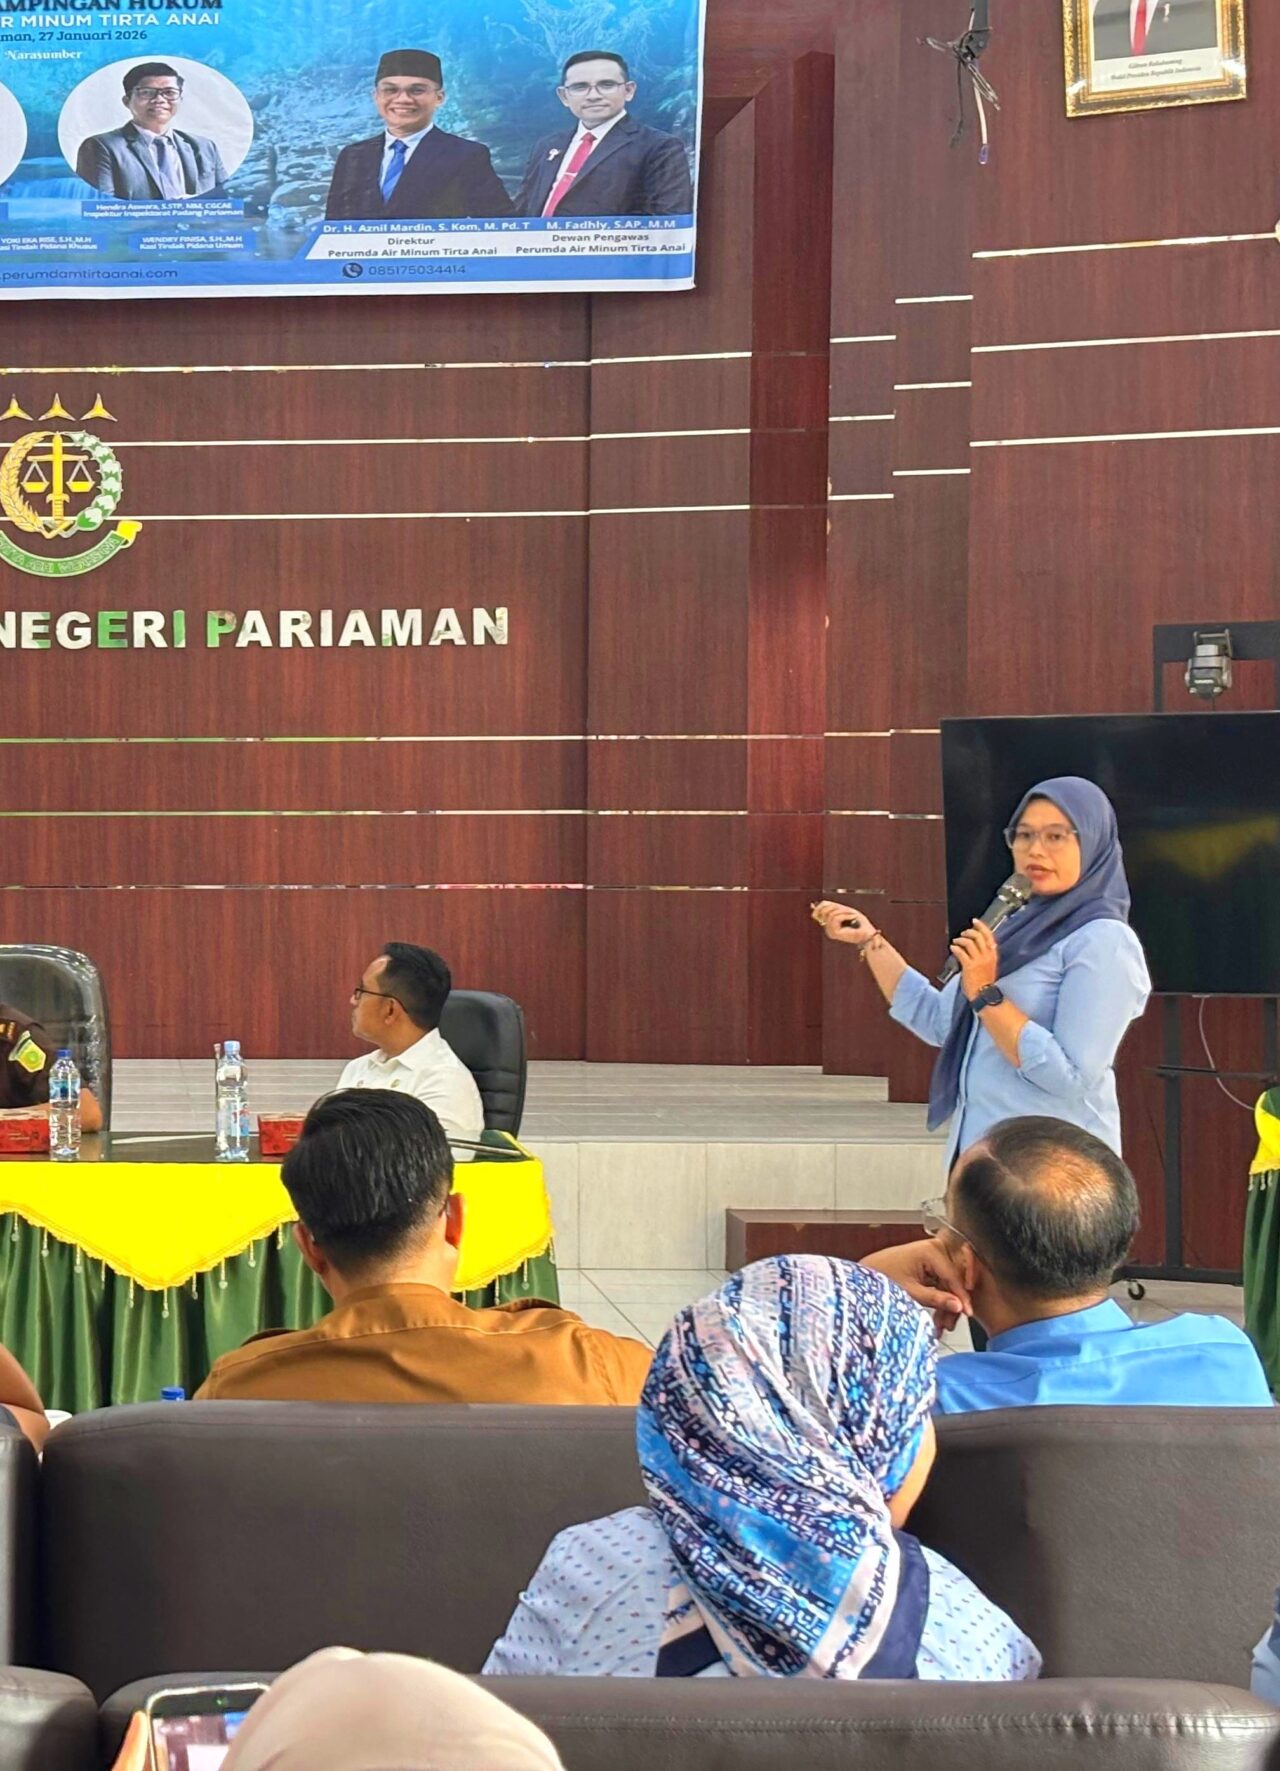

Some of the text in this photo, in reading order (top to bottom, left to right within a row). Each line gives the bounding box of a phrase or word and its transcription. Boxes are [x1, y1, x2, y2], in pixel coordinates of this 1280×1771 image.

[128, 0, 223, 10] HUKUM
[21, 14, 92, 28] MINUM
[98, 13, 160, 26] TIRTA
[166, 13, 219, 25] ANAI
[39, 31, 54, 42] 27
[57, 30, 112, 41] Januari
[115, 30, 148, 41] 2026
[4, 49, 82, 60] Narasumber
[323, 225, 340, 233] Dr.
[343, 224, 356, 232] H.
[358, 223, 387, 232] Aznil
[438, 223, 449, 231] S.
[484, 222, 498, 230] M.
[502, 221, 520, 230] Pd.
[522, 221, 530, 229] T
[547, 221, 562, 229] M.
[387, 237, 435, 245] Direktur
[552, 233, 650, 243] Dewan Pengawas
[328, 247, 497, 257] Perumda Air Minum Tirta Anai
[516, 243, 686, 254] Perumda Air Minum Tirta Anai
[368, 264, 466, 276] 085175034414
[206, 606, 509, 648] PARIAMAN
